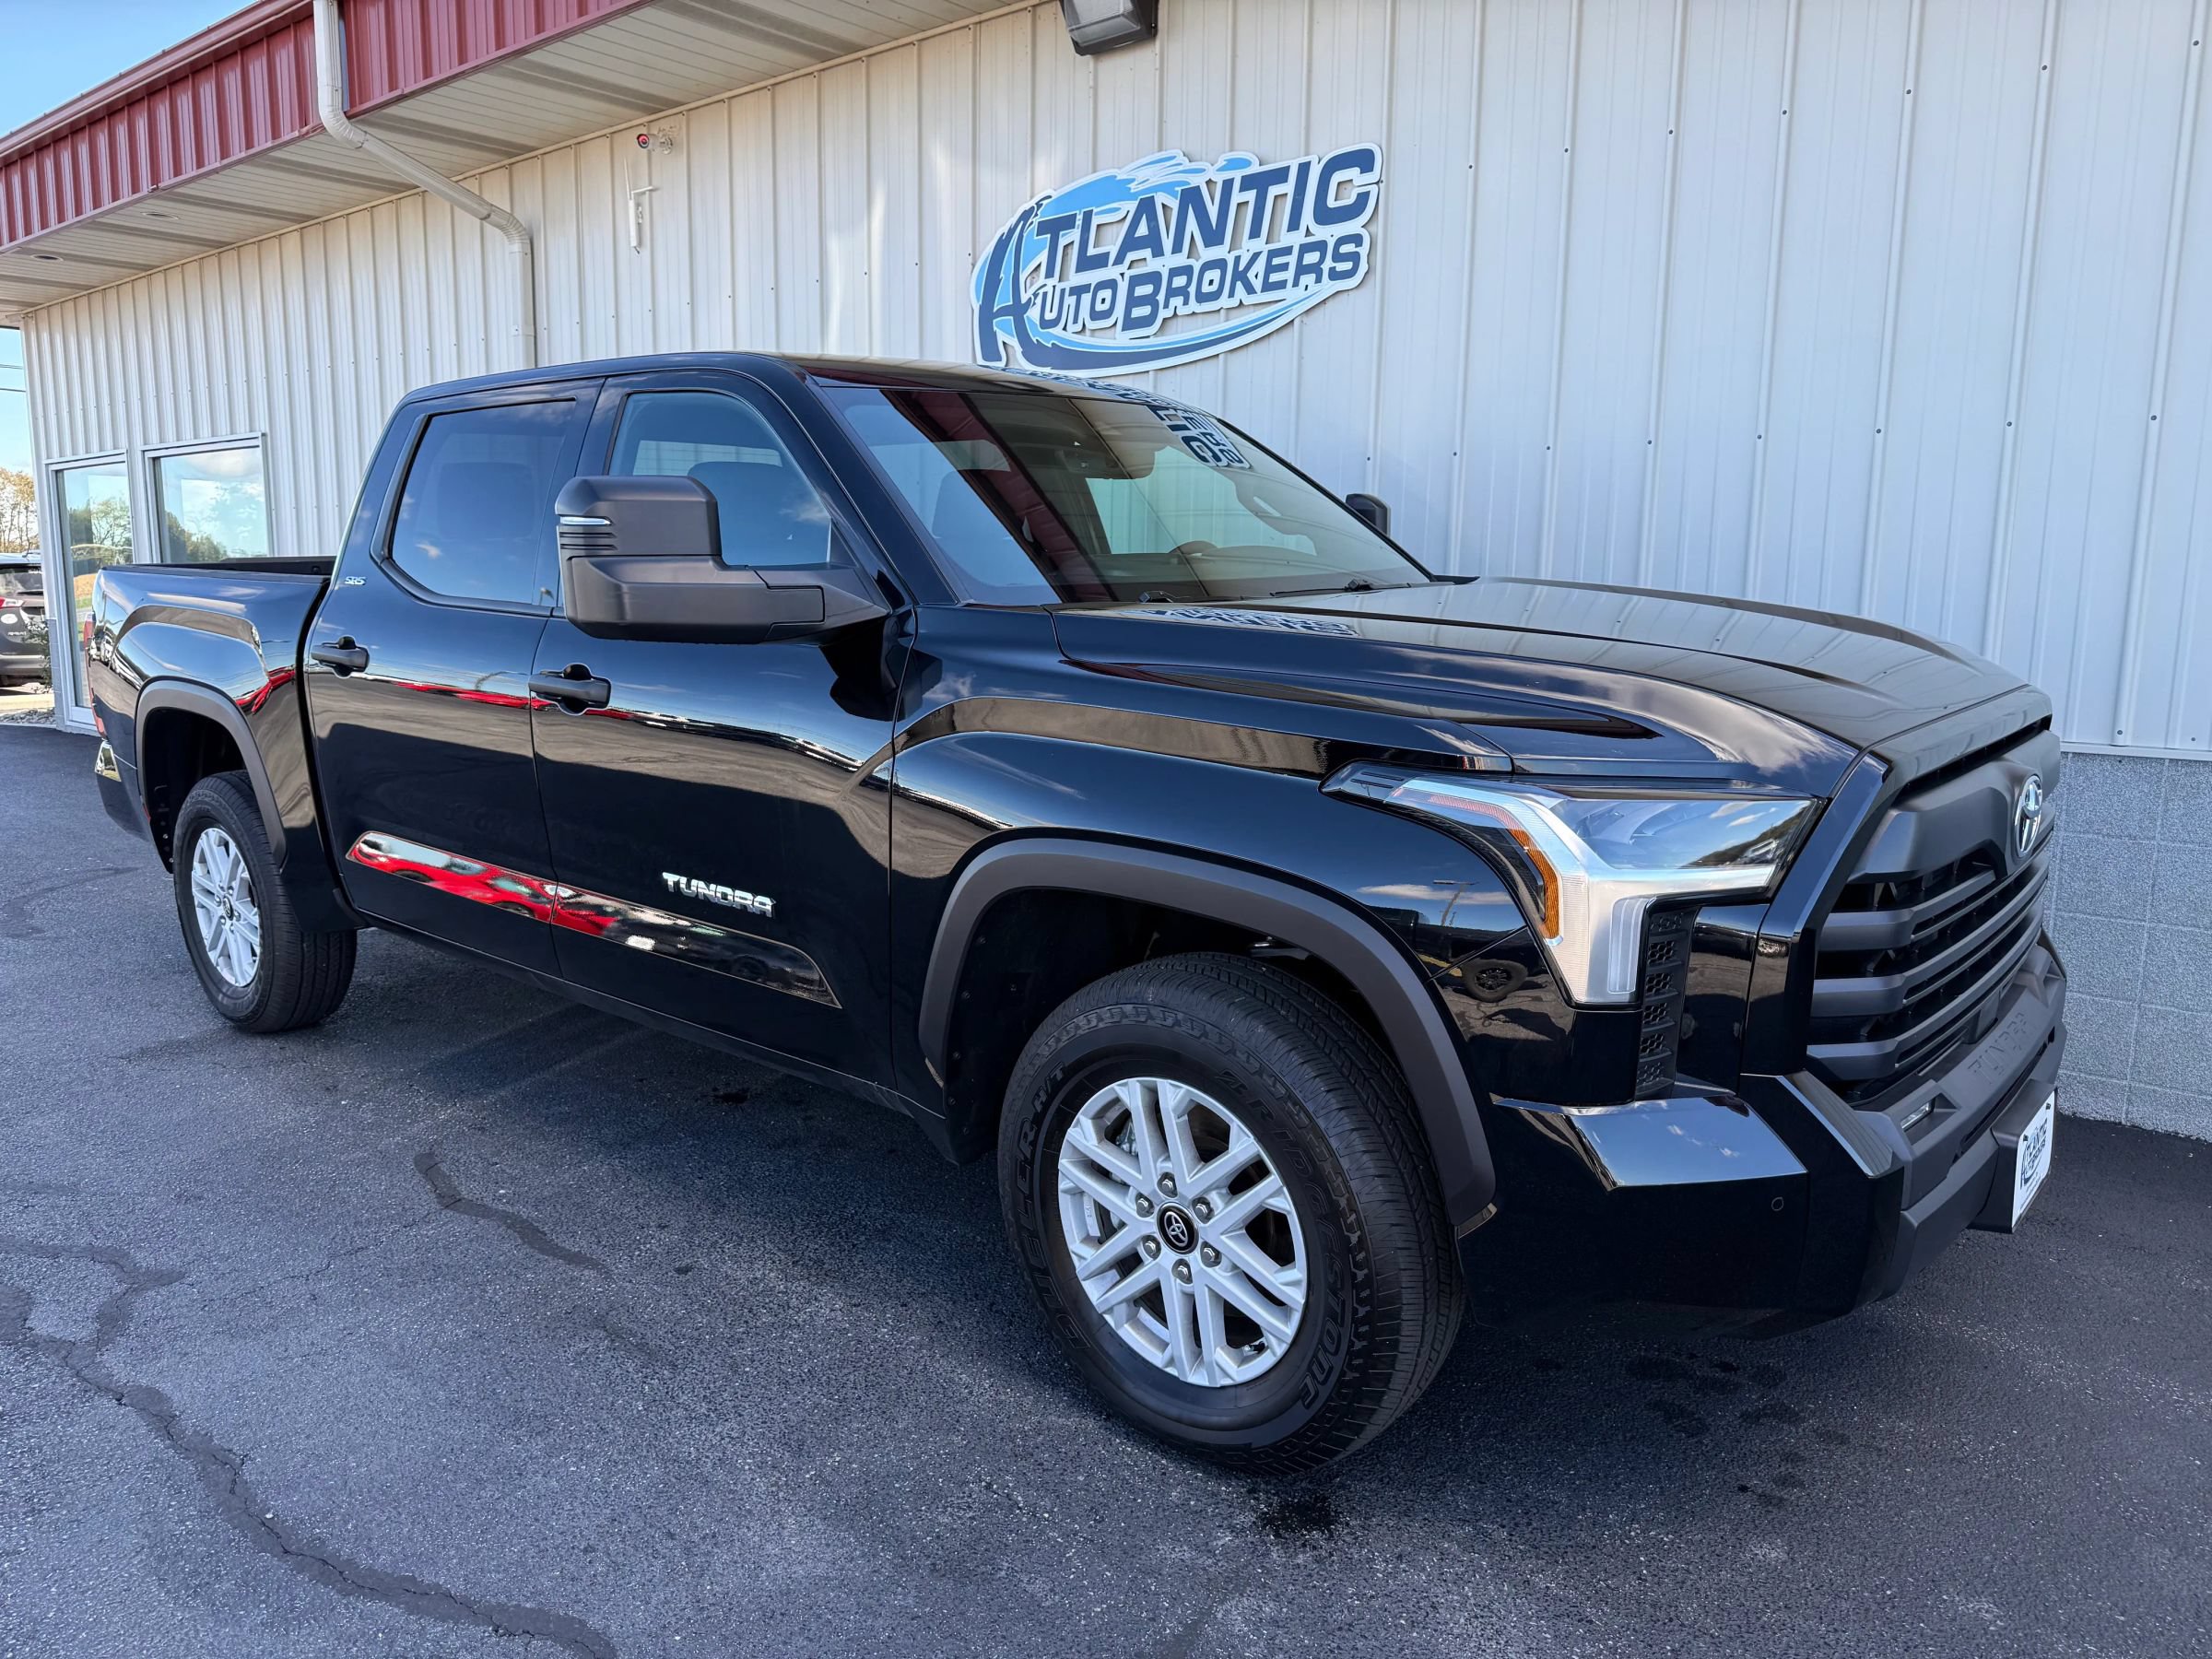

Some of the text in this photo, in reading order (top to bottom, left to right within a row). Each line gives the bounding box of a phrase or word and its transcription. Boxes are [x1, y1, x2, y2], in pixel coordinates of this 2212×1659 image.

[979, 147, 1376, 363] ATLANTIC
[662, 871, 776, 918] TUNDRA
[1215, 1069, 1346, 1409] BRIDGESTONE
